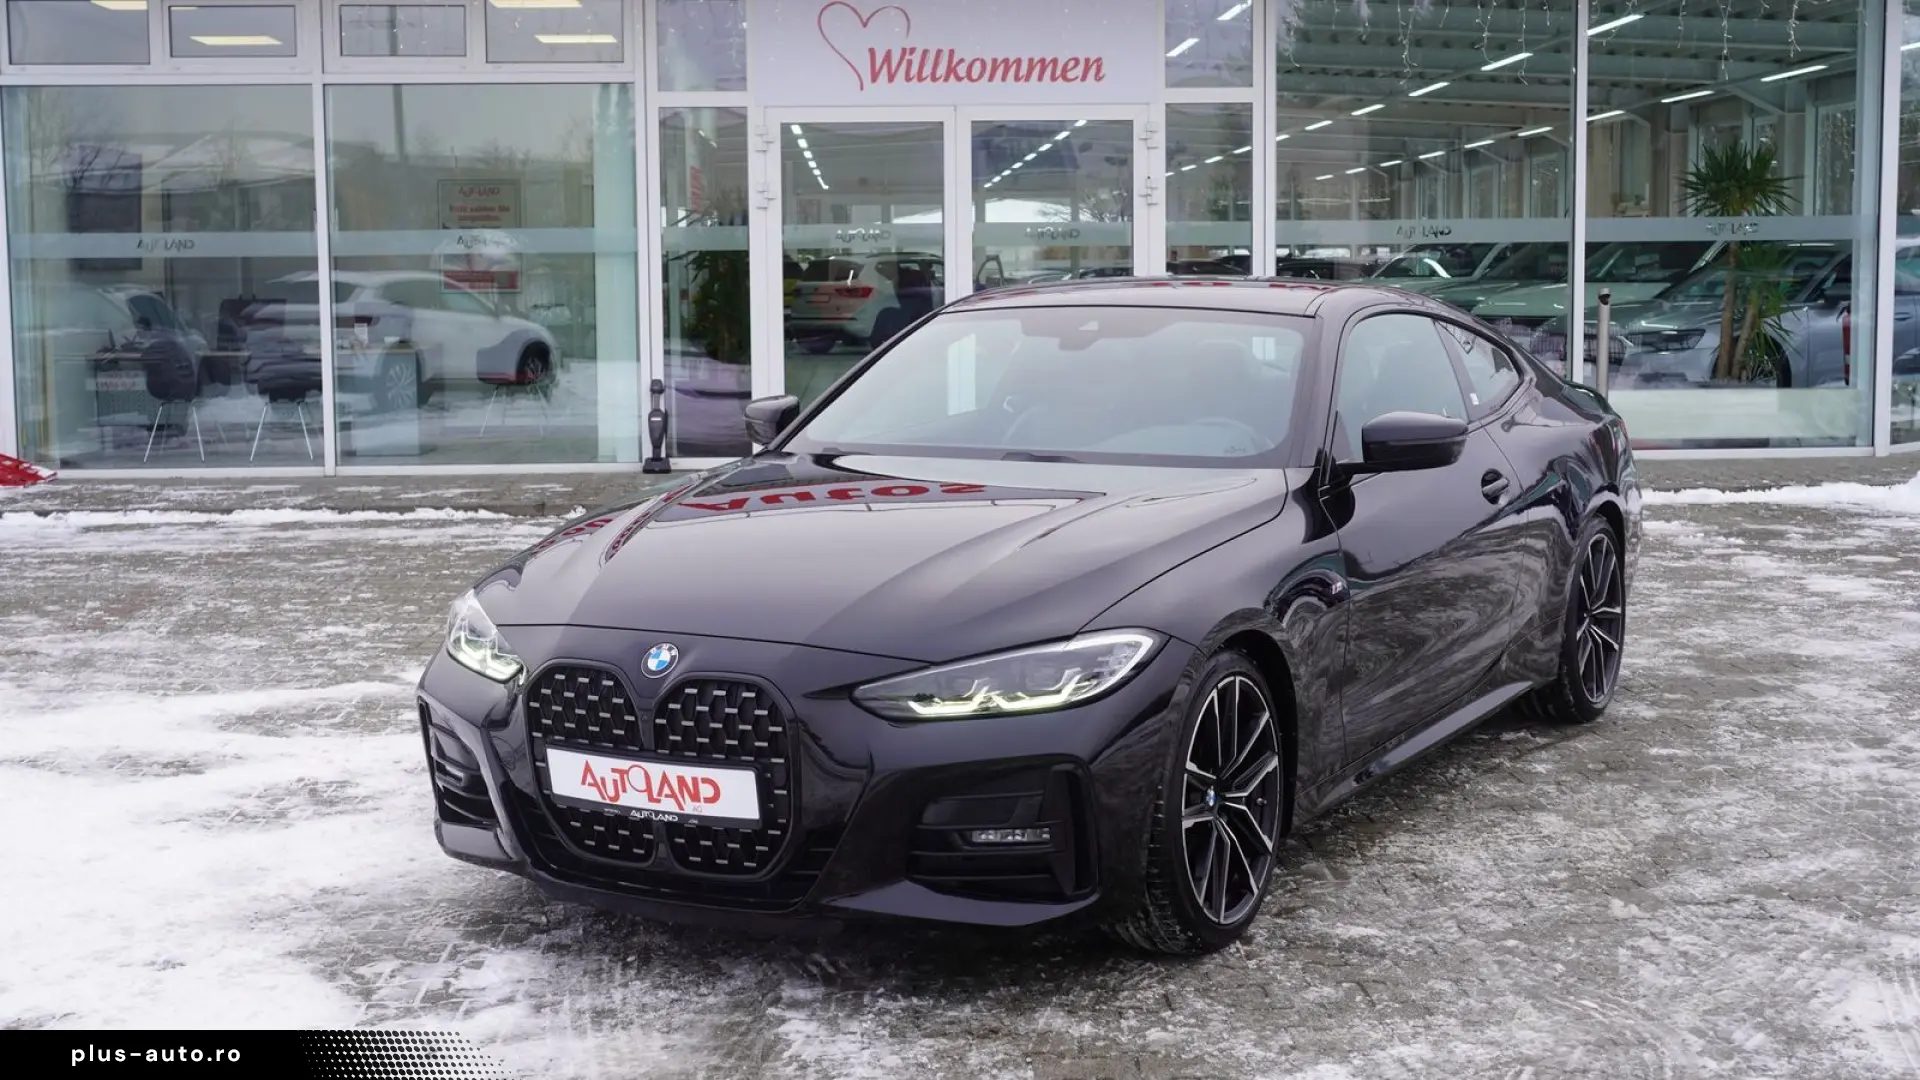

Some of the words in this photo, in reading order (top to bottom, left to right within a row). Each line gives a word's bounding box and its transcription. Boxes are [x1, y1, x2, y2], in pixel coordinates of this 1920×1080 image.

[868, 47, 1105, 84] Willkommen
[1396, 225, 1452, 239] AUTLAND
[581, 759, 721, 812] AUTOLAND
[630, 809, 679, 822] AUTOLAND
